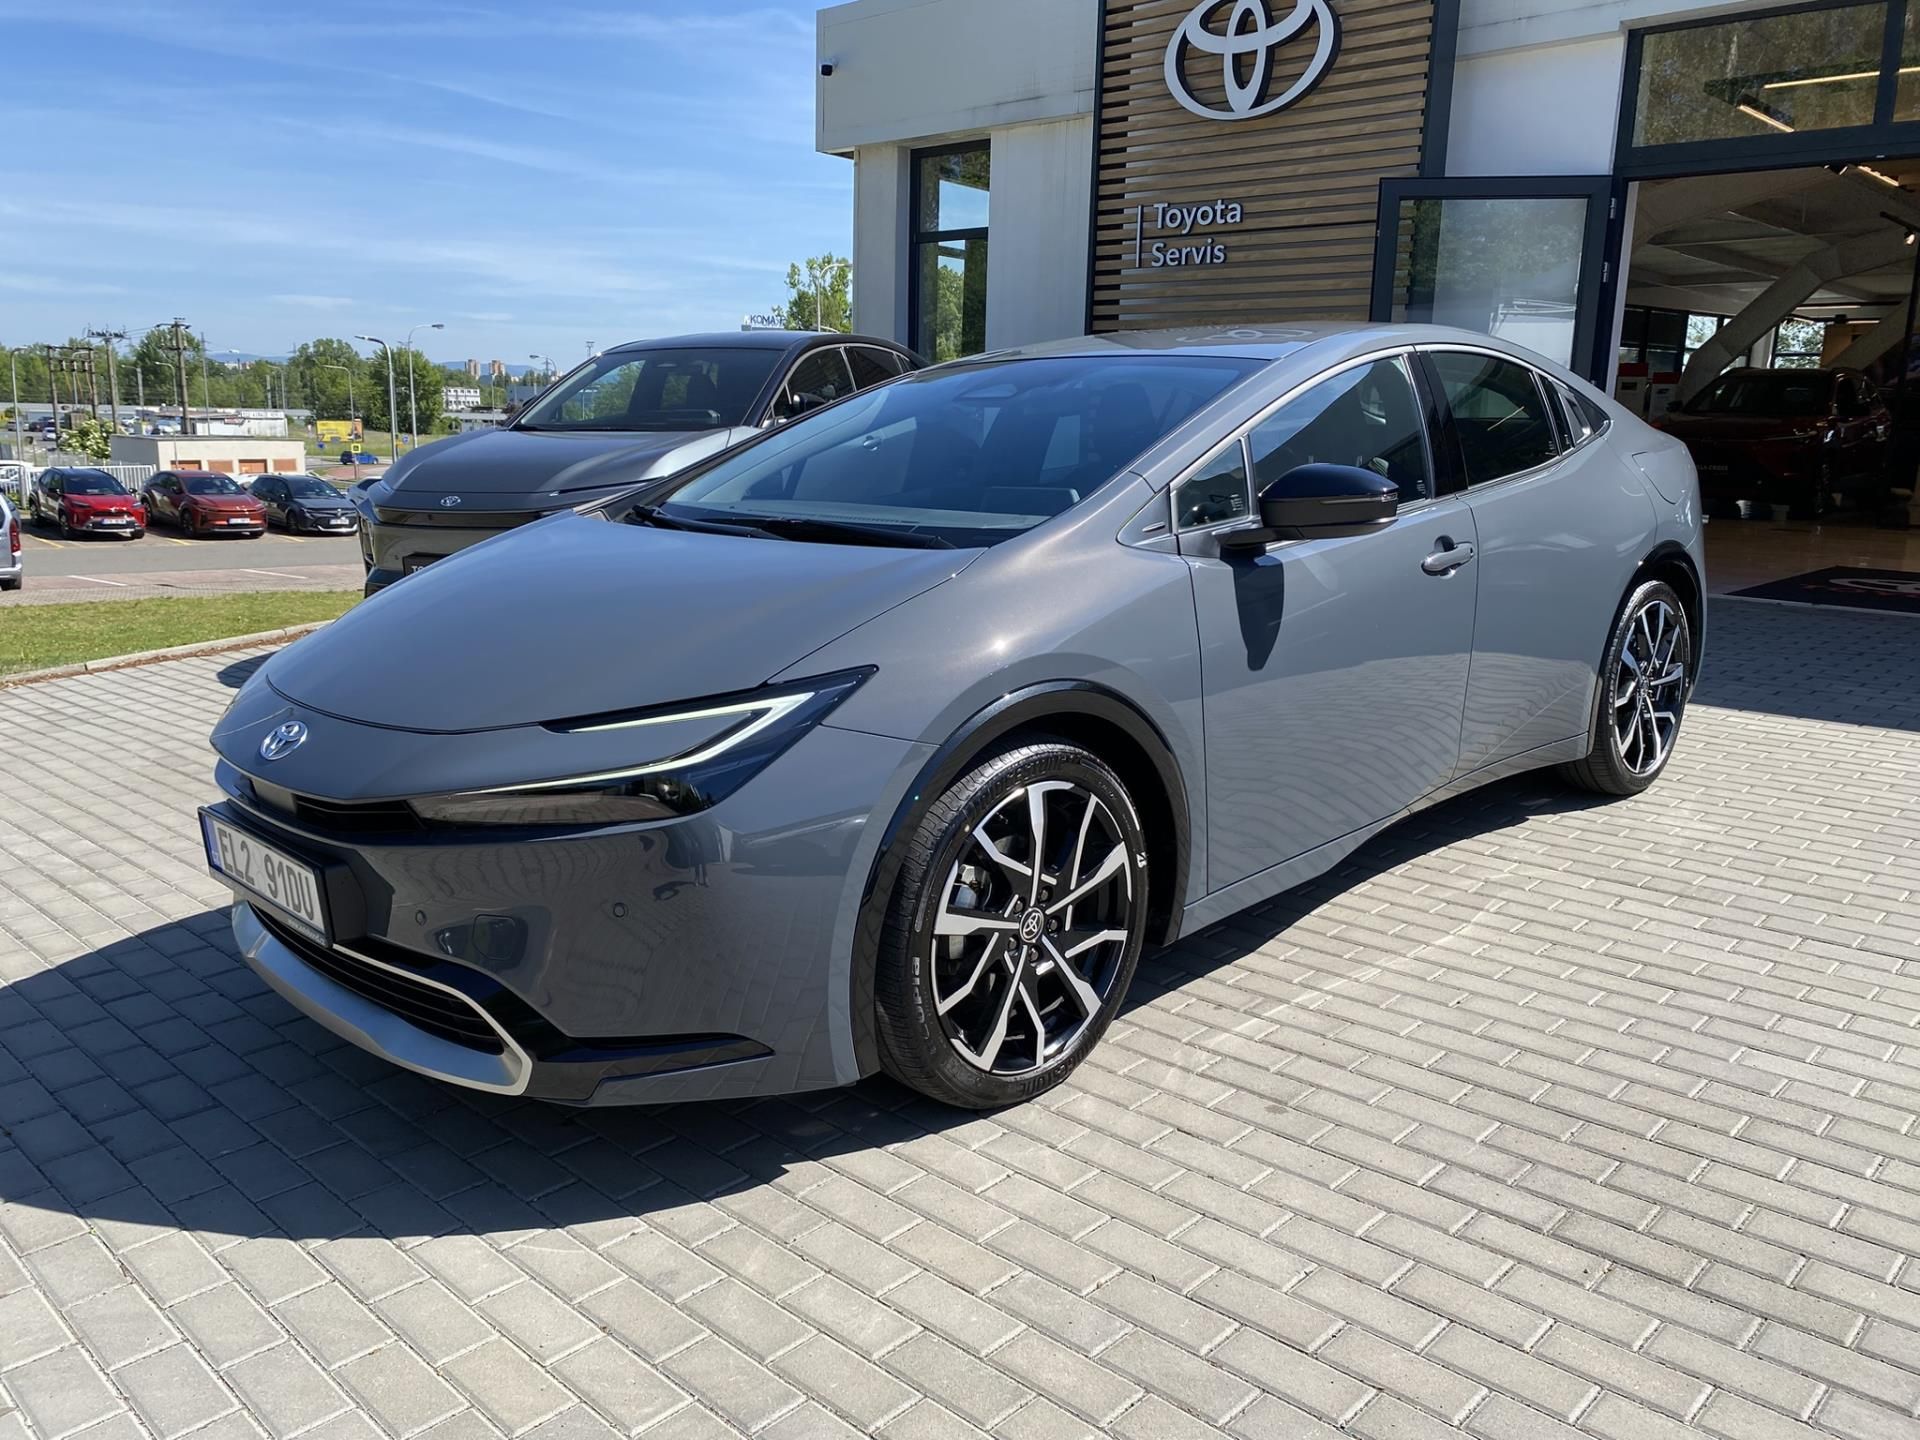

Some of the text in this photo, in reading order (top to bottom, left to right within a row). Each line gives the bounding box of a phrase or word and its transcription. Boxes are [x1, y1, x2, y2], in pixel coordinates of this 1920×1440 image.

[1153, 199, 1242, 234] Toyota
[1151, 238, 1226, 267] Servis
[217, 827, 314, 921] EL2 91DU
